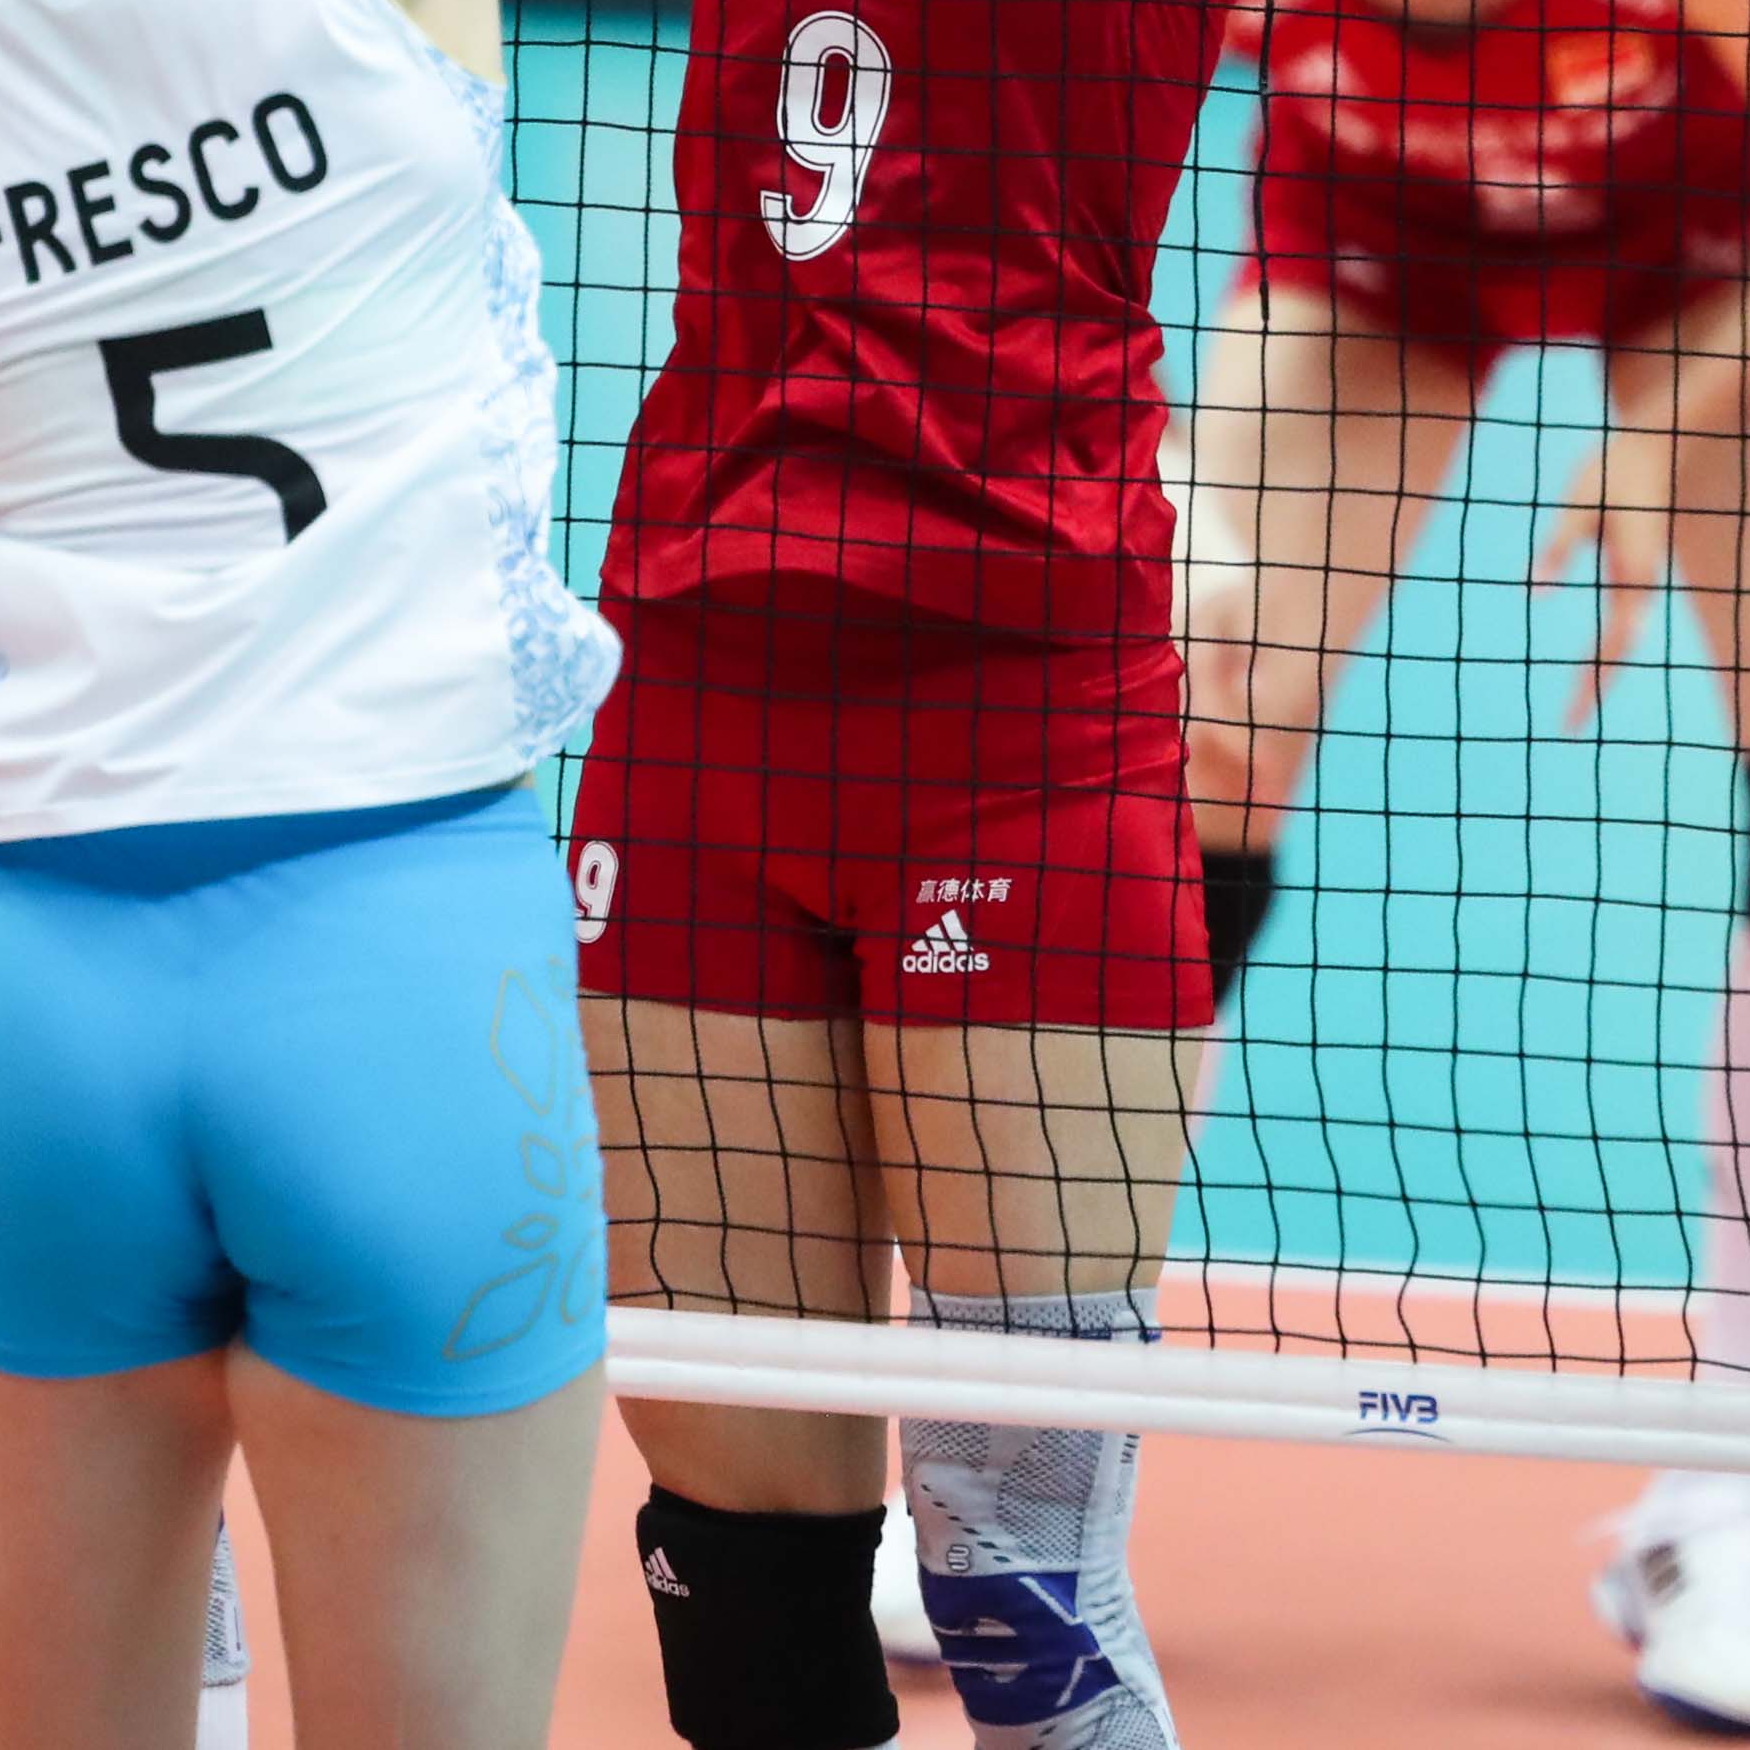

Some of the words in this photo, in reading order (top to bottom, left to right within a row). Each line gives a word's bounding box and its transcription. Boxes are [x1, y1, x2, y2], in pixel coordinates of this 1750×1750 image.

[759, 10, 892, 261] 9
[97, 307, 328, 546] 5
[573, 840, 619, 944] 9
[902, 948, 990, 973] adidas
[1359, 1391, 1439, 1423] FIVB
